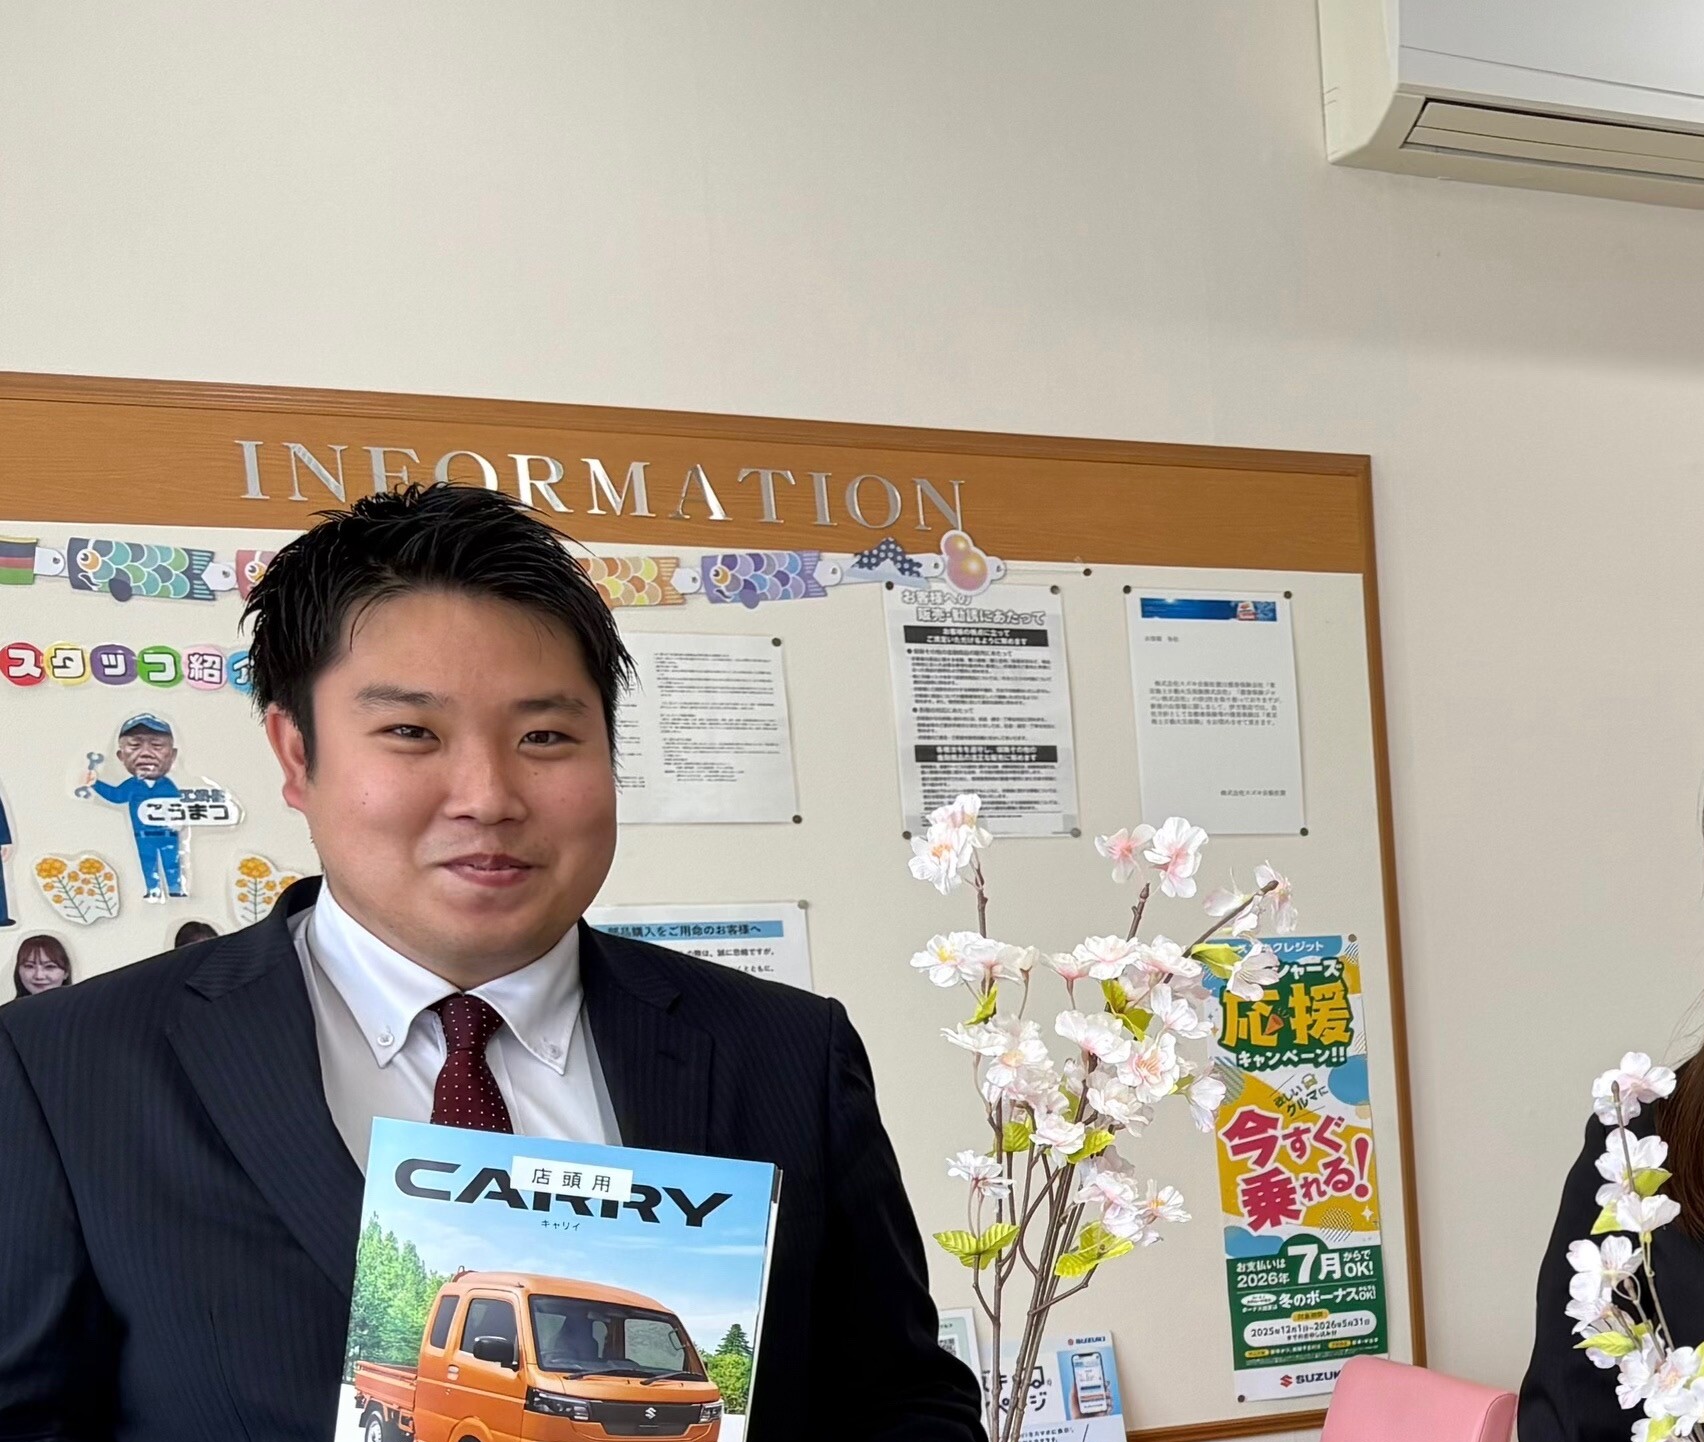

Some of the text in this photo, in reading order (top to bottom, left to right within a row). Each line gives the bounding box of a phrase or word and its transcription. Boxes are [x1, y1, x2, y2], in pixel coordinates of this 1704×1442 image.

[233, 440, 966, 531] INFORMATION
[146, 804, 229, 820] こうまつ
[1238, 941, 1324, 953] スクレジット
[1222, 981, 1352, 1048] 応援
[1286, 1085, 1329, 1117] クルマに
[1221, 1109, 1345, 1168] 今すぐ
[531, 1167, 612, 1193] 店頭用
[541, 1219, 581, 1232] キャリイ
[1287, 1243, 1342, 1284] 7月
[1344, 1261, 1374, 1277] OK!
[1236, 1272, 1291, 1288] 2026年
[1279, 1287, 1359, 1309] 冬のボーナス
[1296, 1370, 1341, 1384] SUZUK
